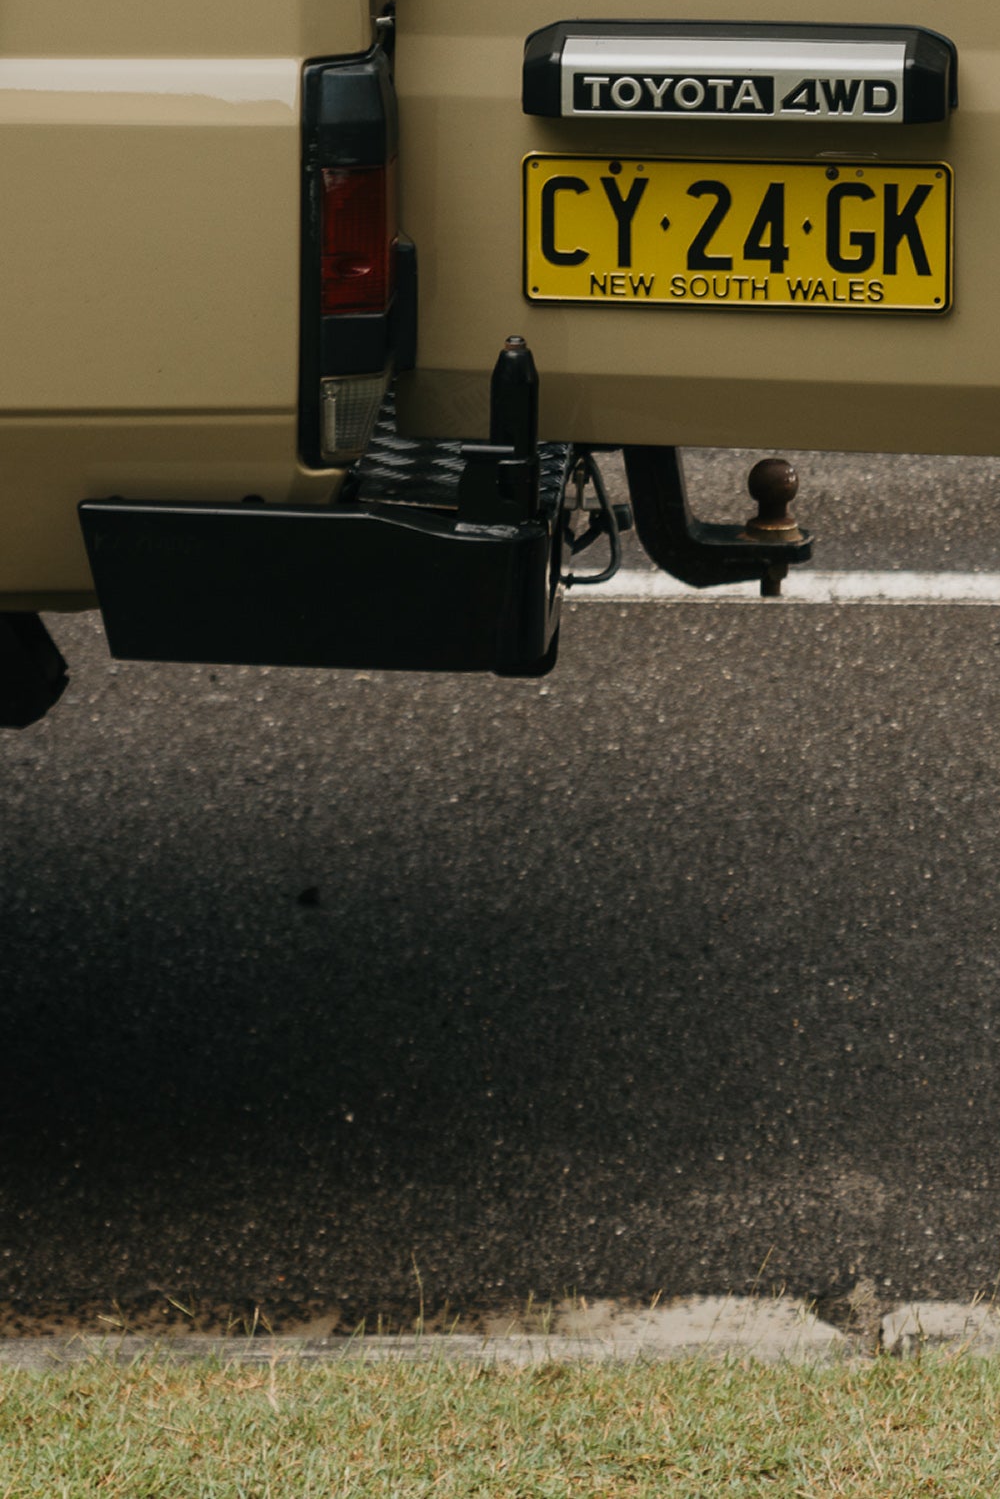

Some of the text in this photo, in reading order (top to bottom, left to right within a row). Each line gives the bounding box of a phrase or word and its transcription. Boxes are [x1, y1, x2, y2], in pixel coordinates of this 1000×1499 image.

[582, 76, 898, 115] TOYOTA 4WD
[590, 272, 885, 302] NEW SOUTH WALES
